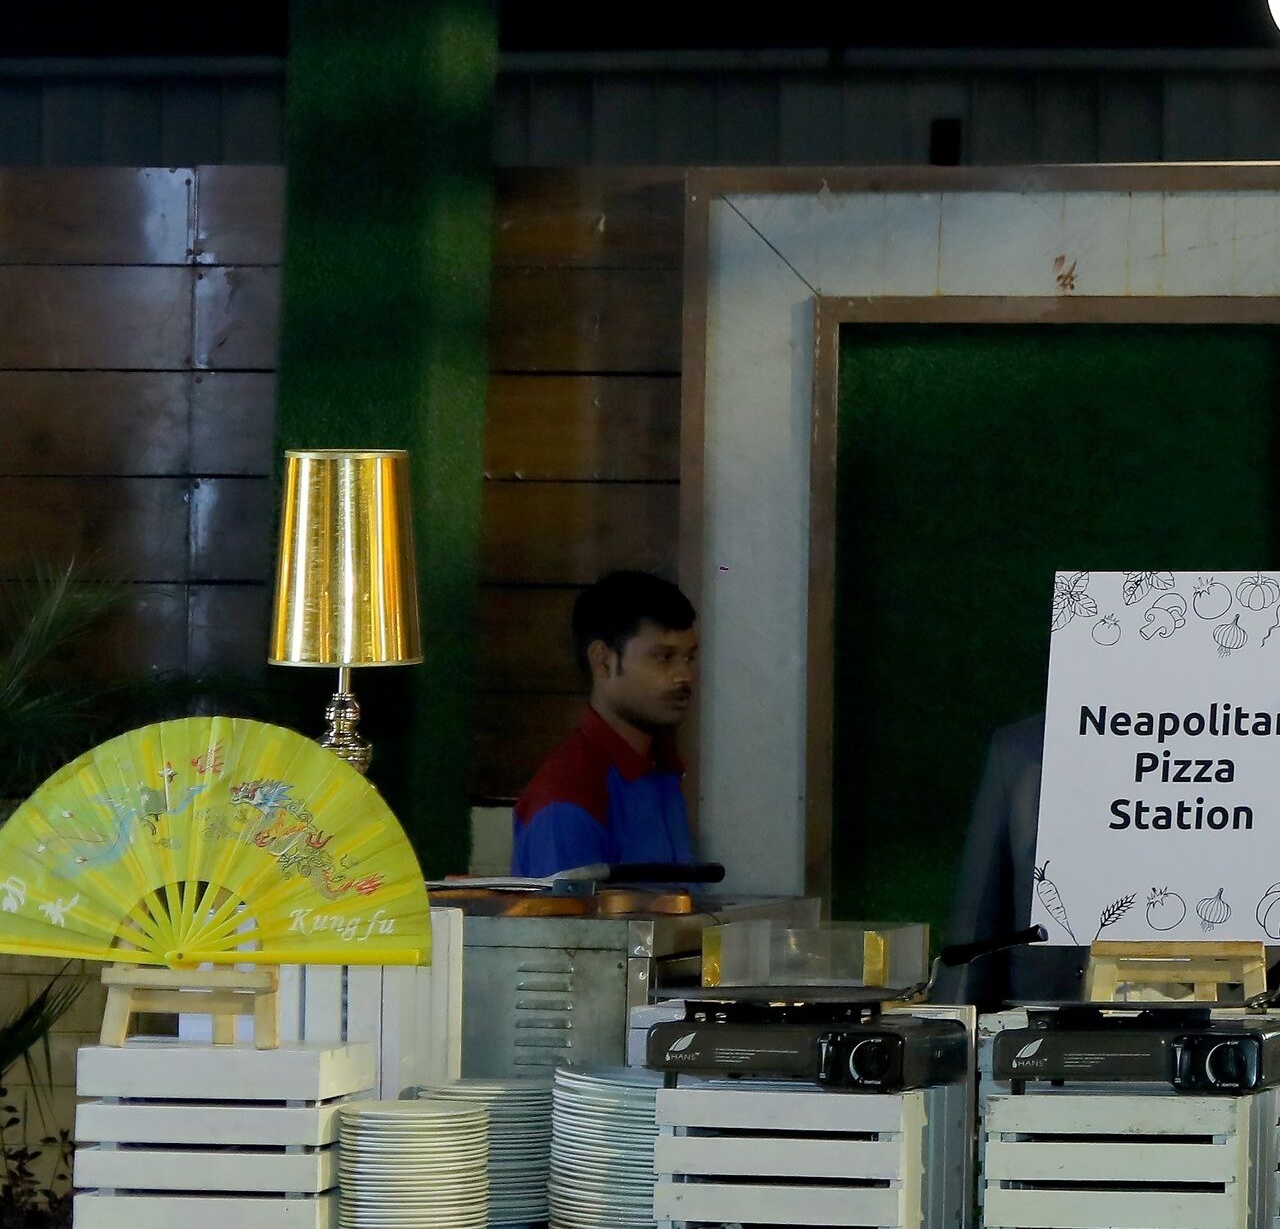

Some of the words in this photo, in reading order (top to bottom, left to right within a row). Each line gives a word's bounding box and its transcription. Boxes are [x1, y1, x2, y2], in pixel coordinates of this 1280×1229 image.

[1135, 749, 1235, 782] Pizza
[1109, 796, 1253, 830] Station
[288, 908, 361, 941] Kung
[357, 909, 395, 941] fu
